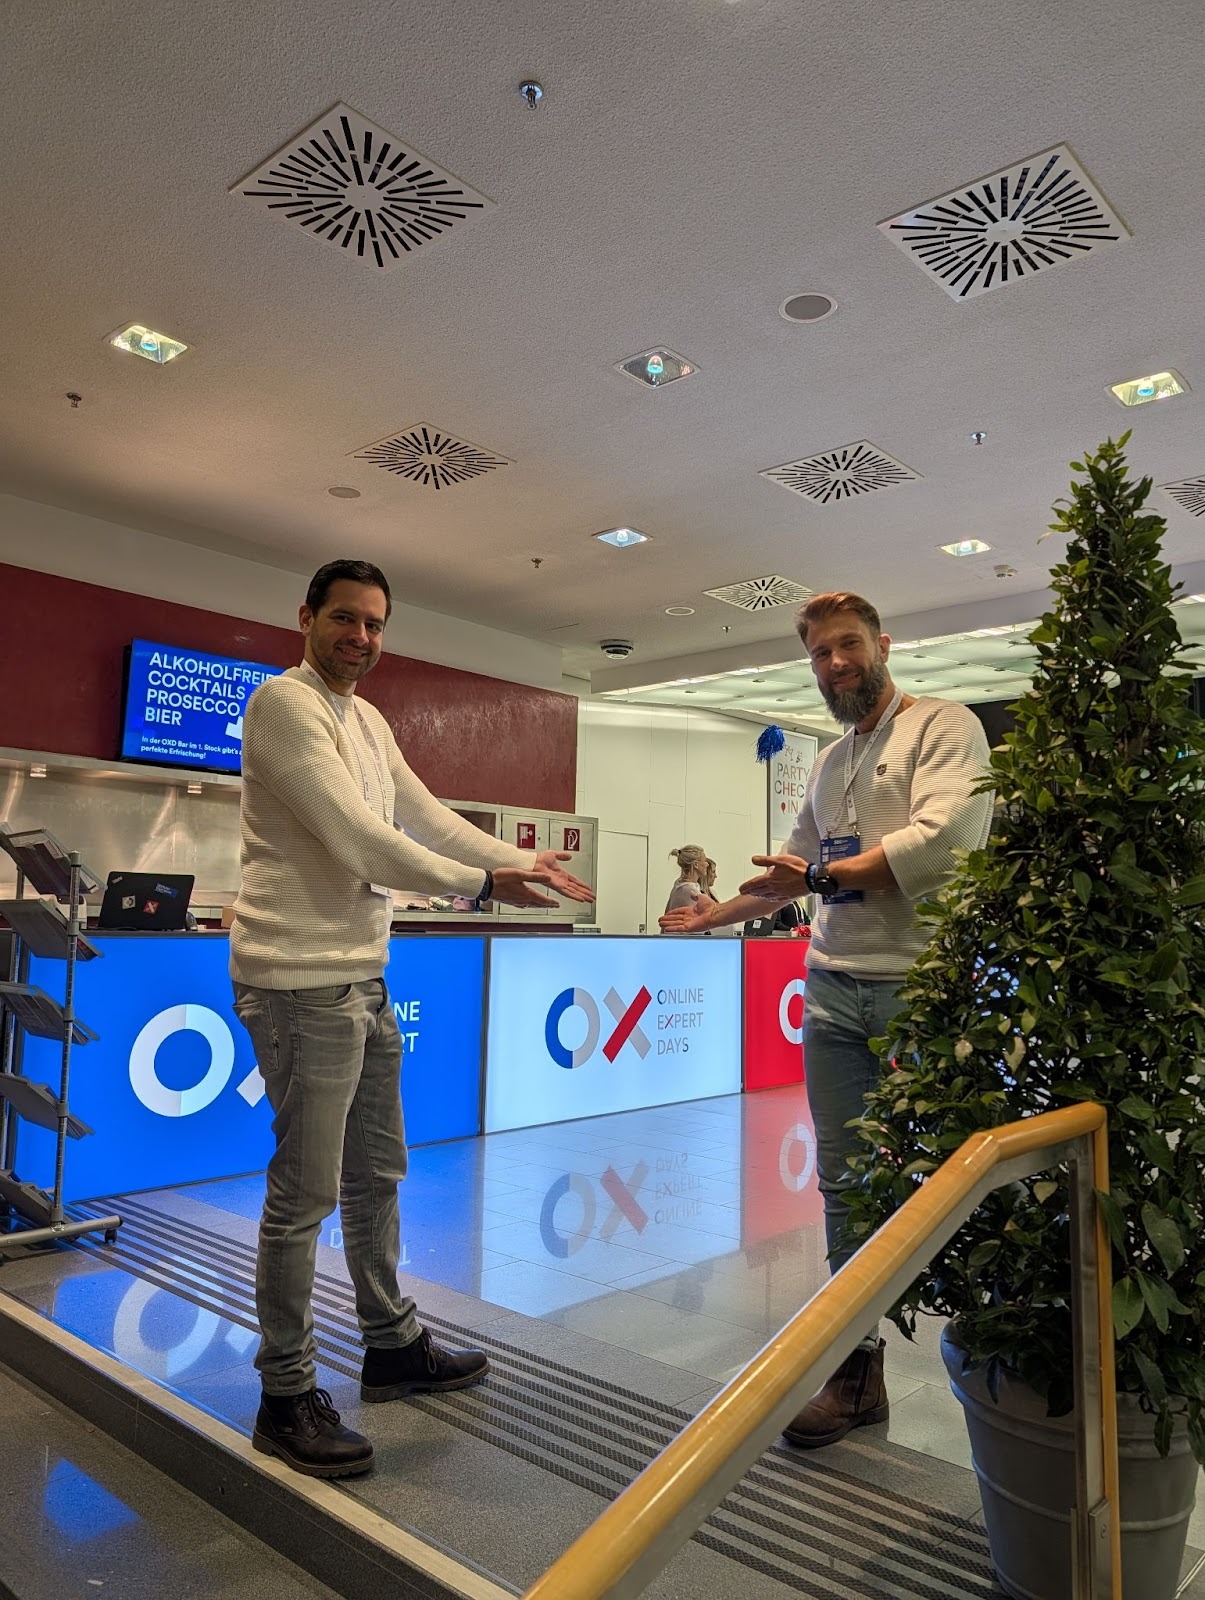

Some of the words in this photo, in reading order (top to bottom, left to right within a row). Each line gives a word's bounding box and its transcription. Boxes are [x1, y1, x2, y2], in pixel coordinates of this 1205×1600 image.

[148, 670, 246, 700] COCKTAILS
[146, 688, 240, 717] PROSECCO
[145, 706, 182, 726] BIER
[140, 745, 168, 754] perfekte
[169, 747, 206, 760] Erfrischung!
[161, 739, 176, 747] OXD
[177, 740, 188, 748] Bar
[204, 744, 221, 753] Stock
[221, 746, 238, 755] gibt's
[777, 762, 810, 781] PARTY
[774, 780, 805, 798] CHEC
[787, 799, 798, 814] IN
[656, 987, 704, 1005] ONLINE
[545, 985, 653, 1069] OX
[657, 1012, 704, 1031] EXPERT
[657, 1037, 689, 1056] DAYS
[129, 1003, 266, 1118] O
